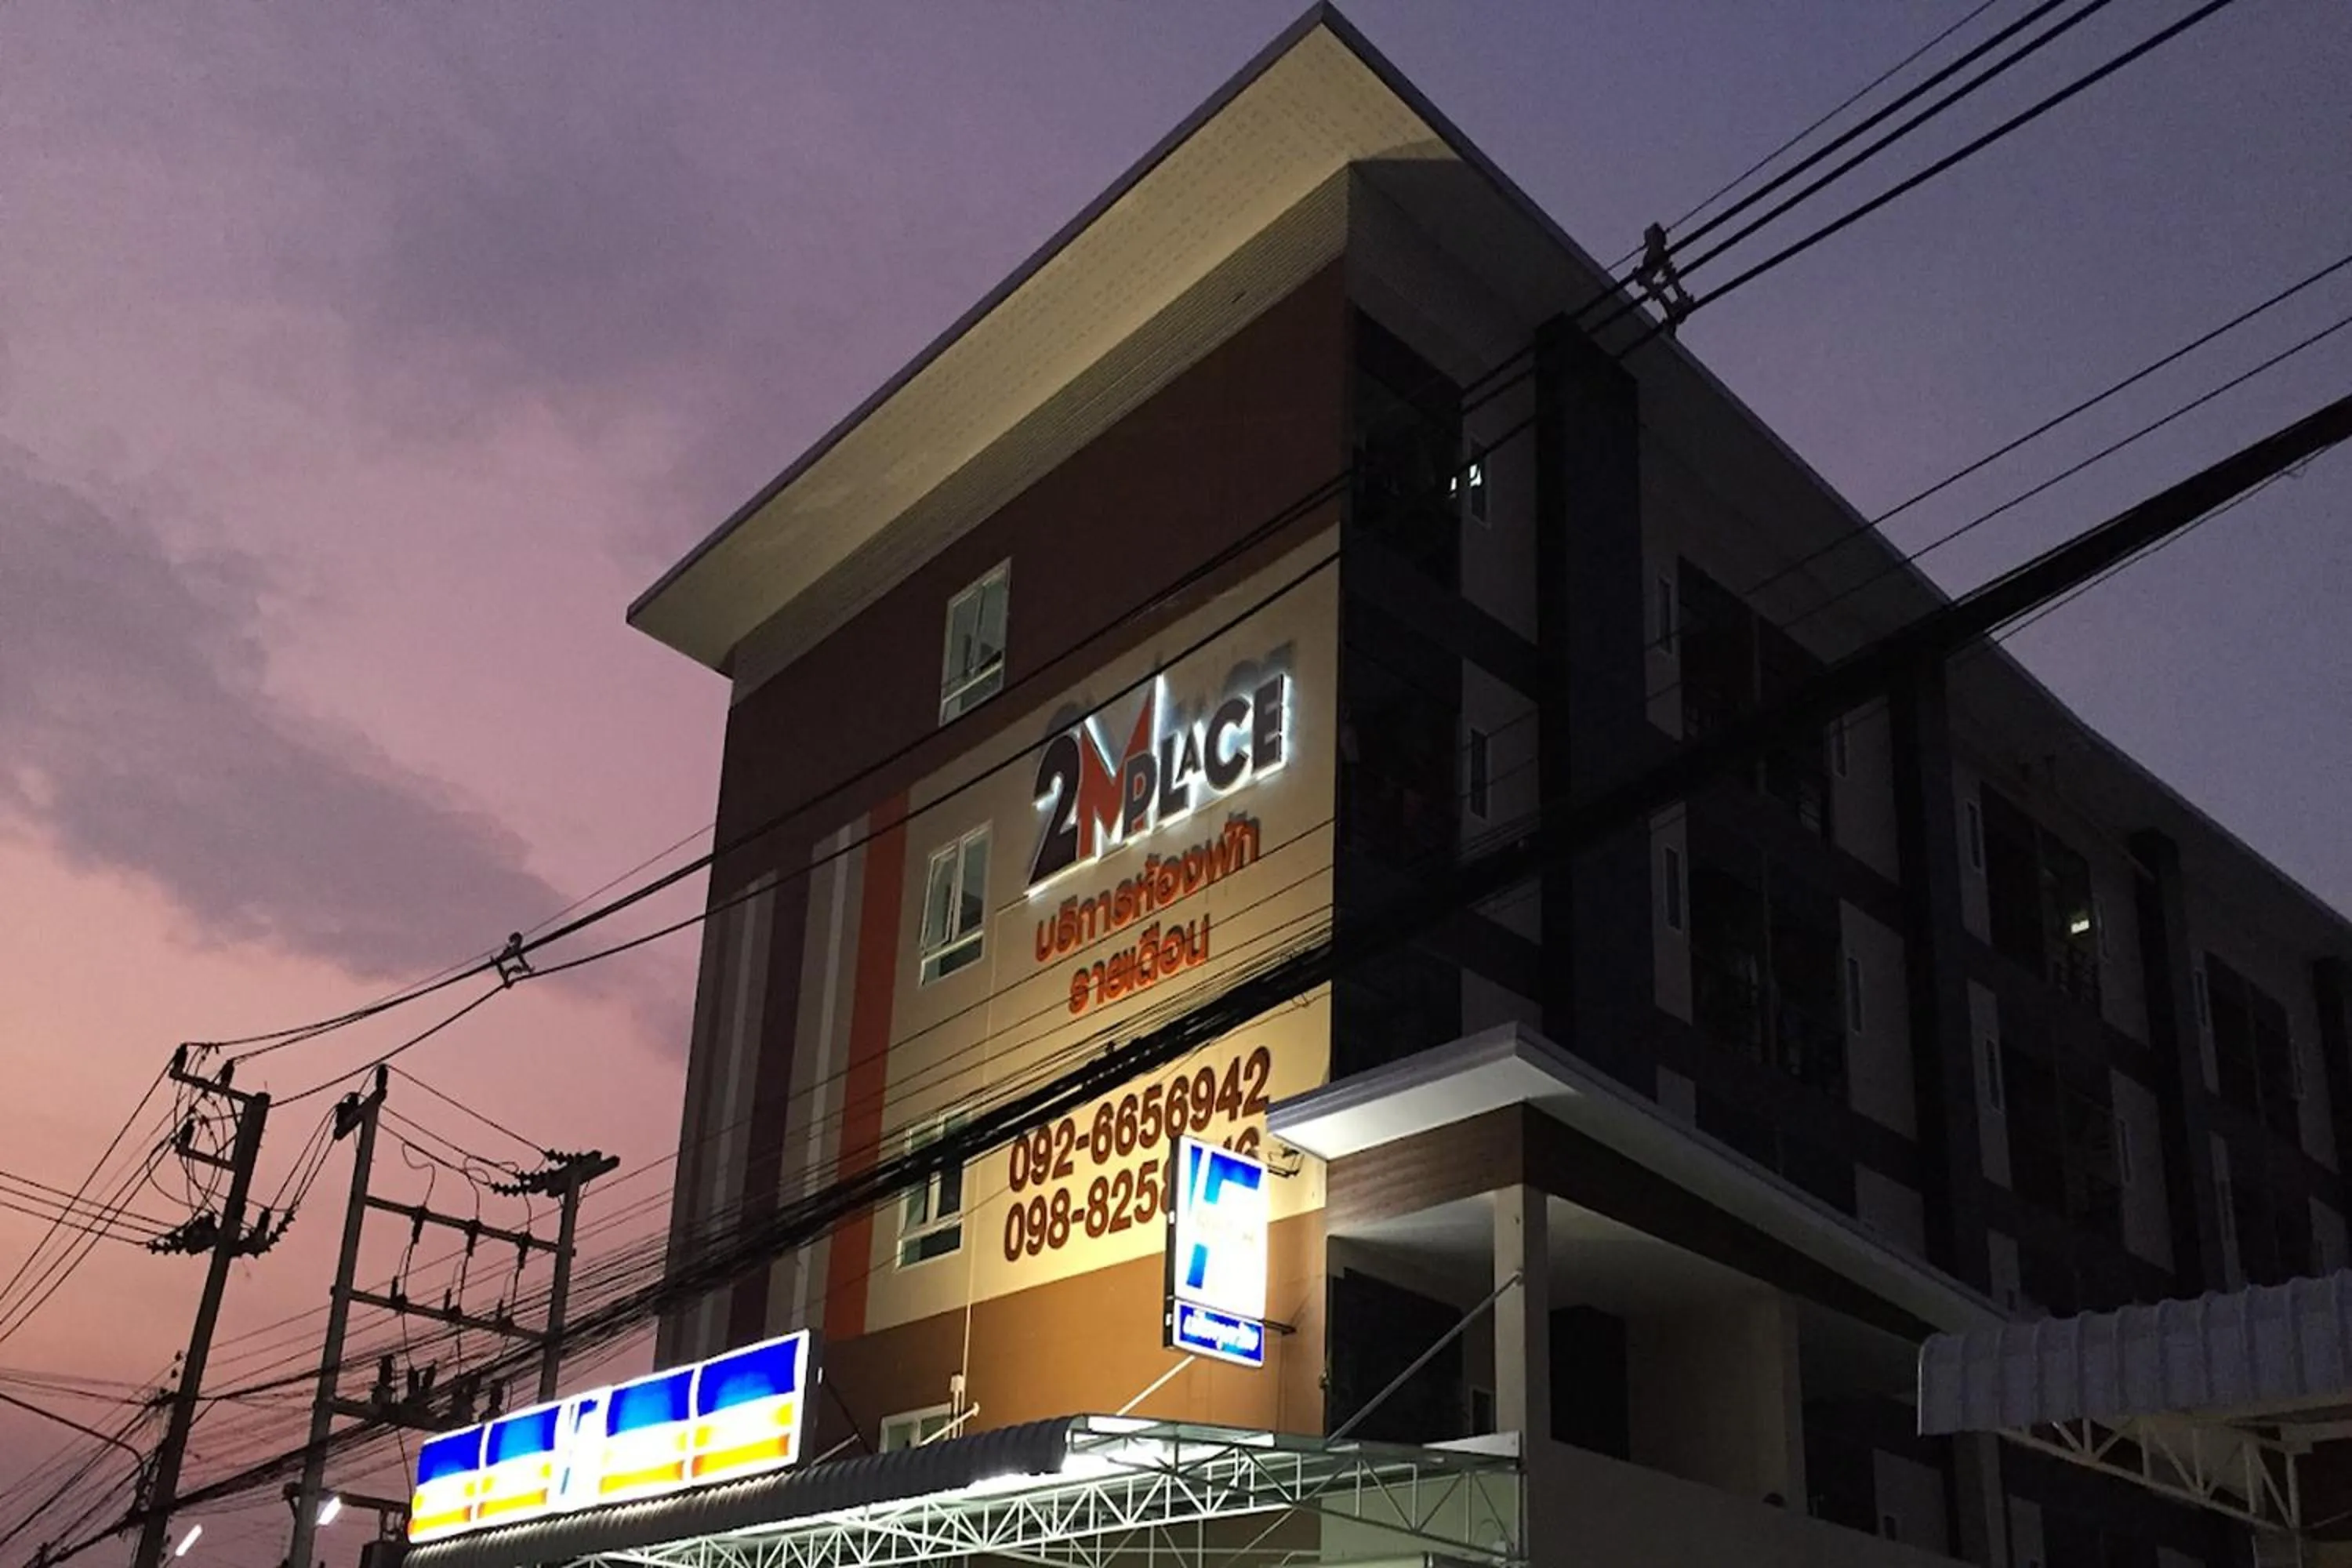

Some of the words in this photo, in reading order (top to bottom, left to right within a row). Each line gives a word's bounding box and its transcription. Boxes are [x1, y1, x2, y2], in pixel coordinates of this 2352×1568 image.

[1036, 815, 1259, 962] บริการห้องพัก
[1068, 915, 1210, 1014] รายเดือน
[1008, 1045, 1272, 1192] 092-6656942
[1004, 1127, 1261, 1262] 098-825
